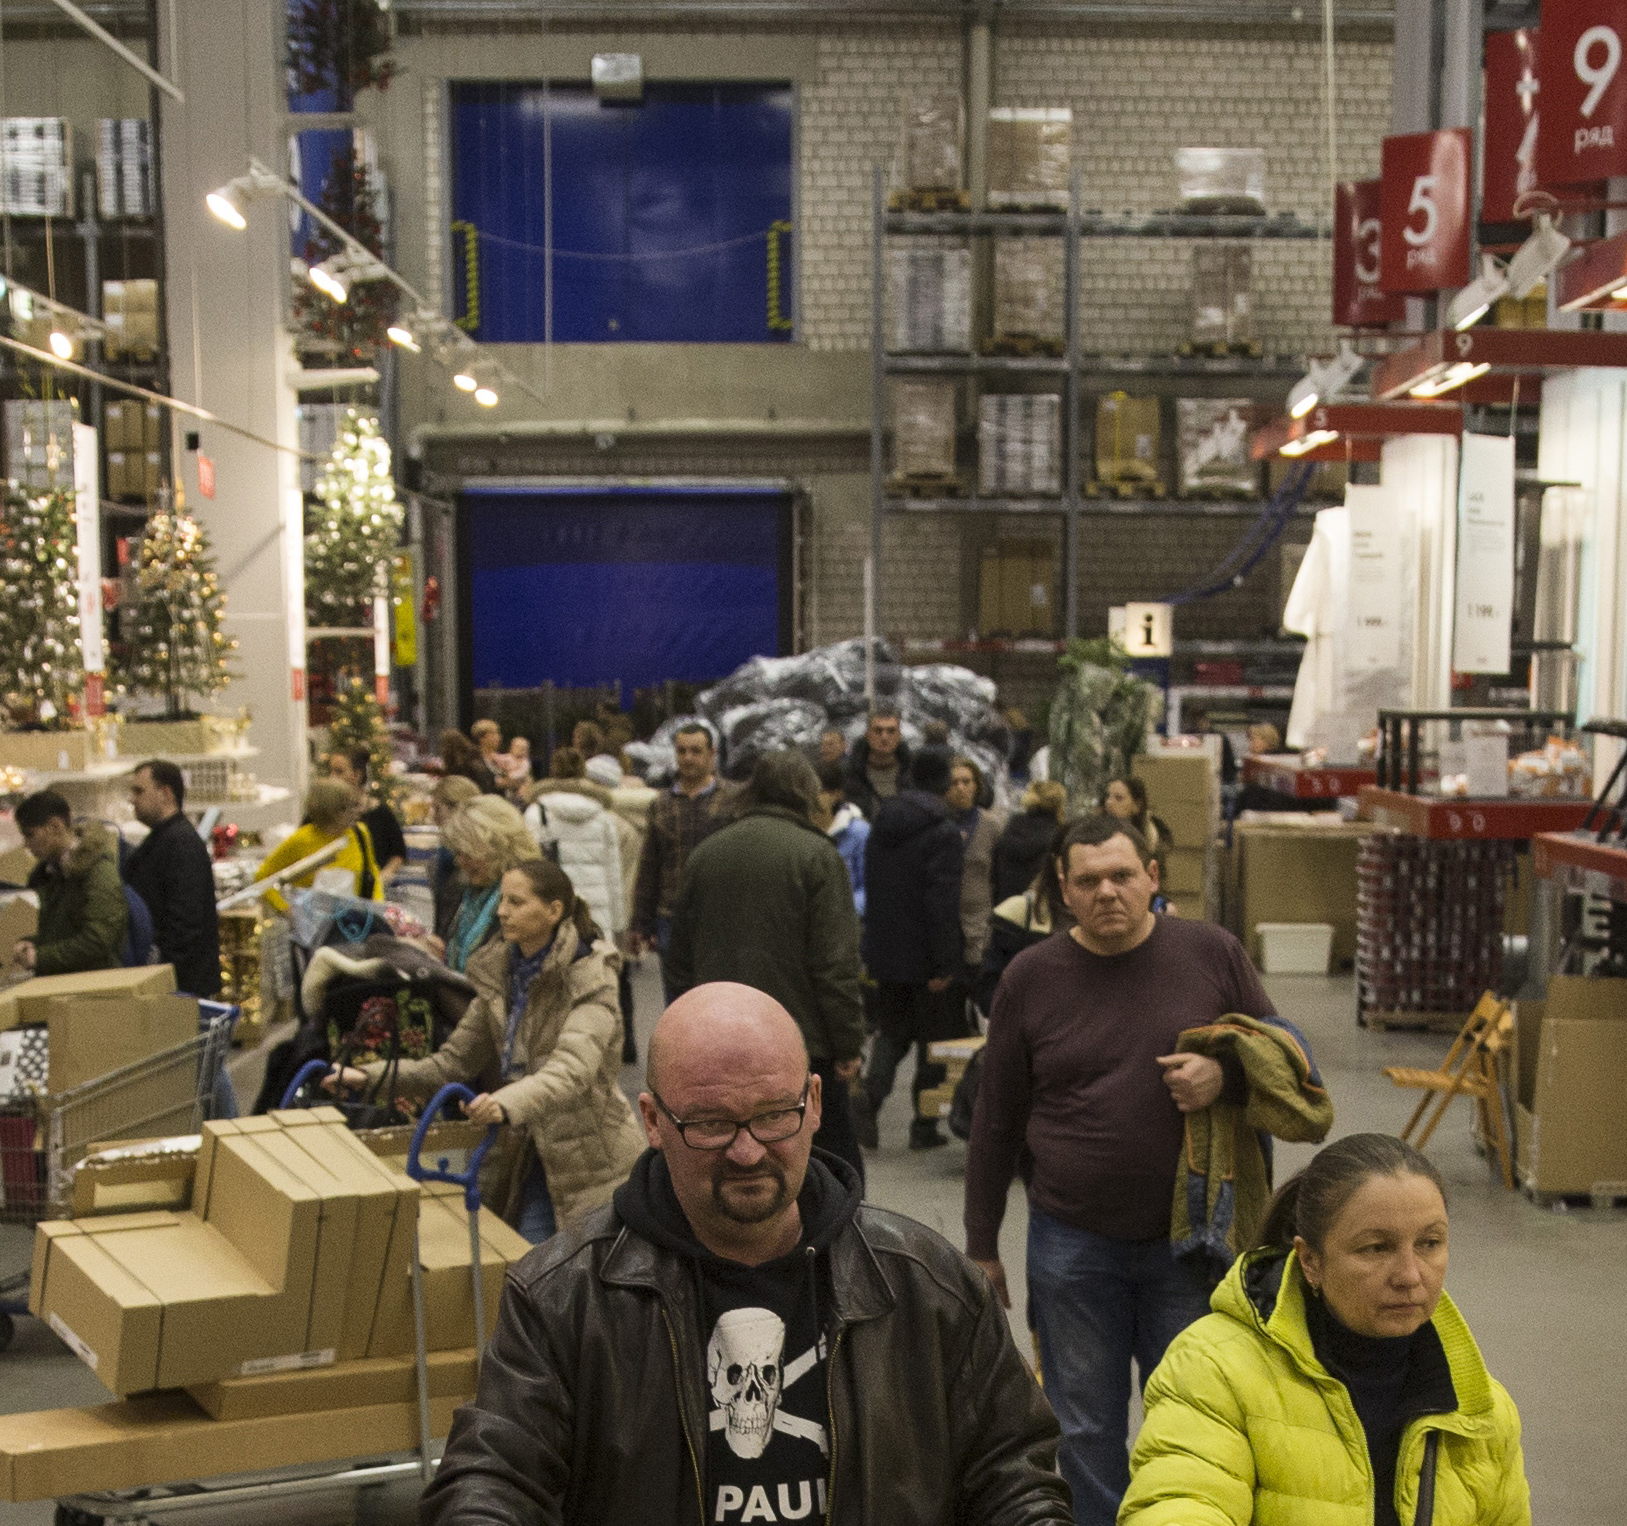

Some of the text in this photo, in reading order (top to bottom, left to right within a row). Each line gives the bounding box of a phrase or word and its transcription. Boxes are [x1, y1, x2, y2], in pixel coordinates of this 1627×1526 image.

[1573, 24, 1622, 119] 9
[1573, 125, 1615, 155] ряд
[1403, 174, 1441, 247] 5
[1355, 218, 1382, 284] 3
[1454, 333, 1473, 357] 9
